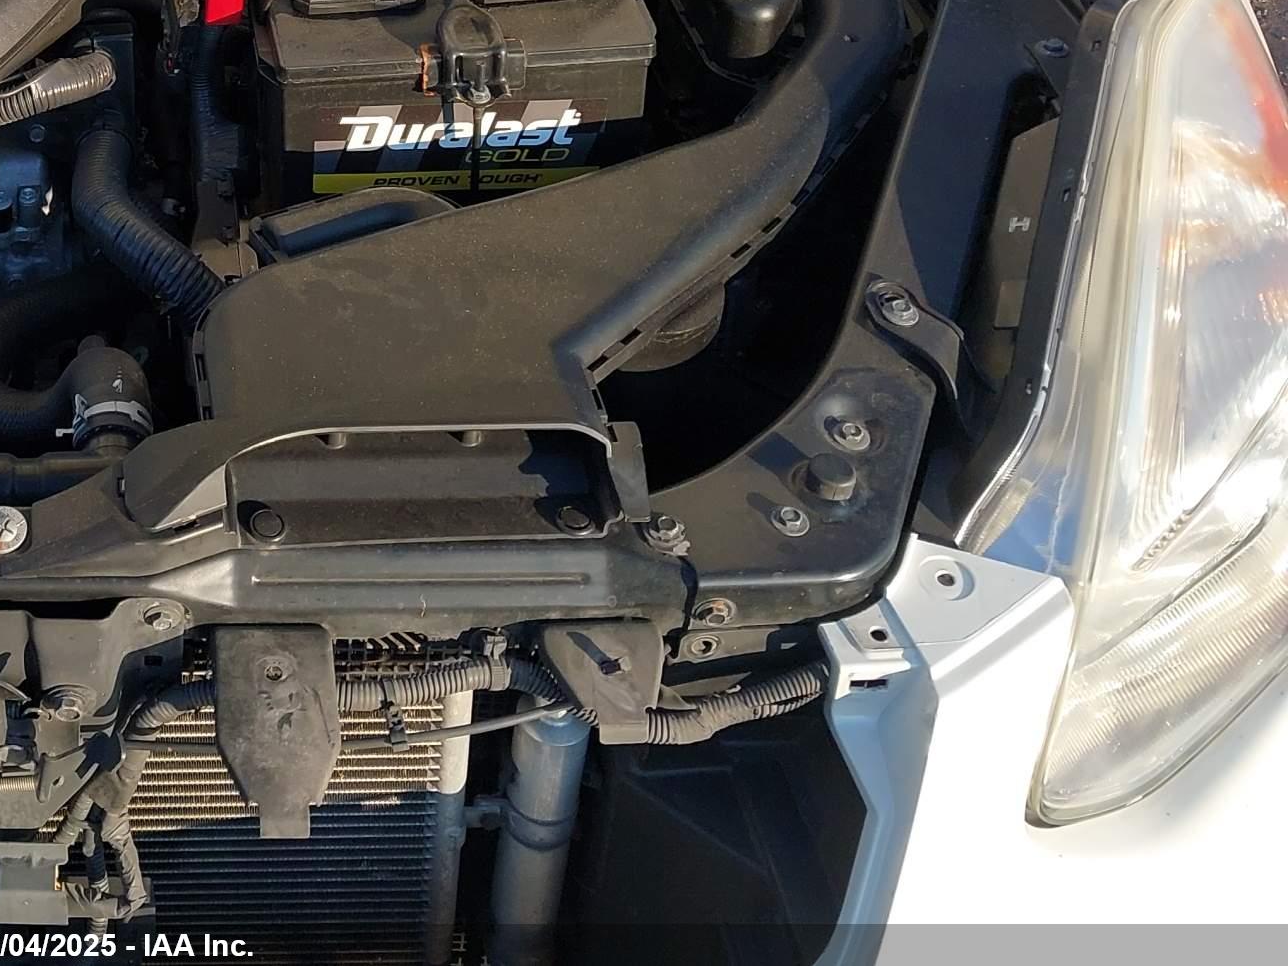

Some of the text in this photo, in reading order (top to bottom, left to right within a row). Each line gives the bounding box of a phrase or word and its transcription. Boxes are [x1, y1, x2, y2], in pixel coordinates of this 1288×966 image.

[339, 108, 582, 153] Duralast
[465, 147, 570, 164] GOLD
[373, 175, 460, 187] PROVEN
